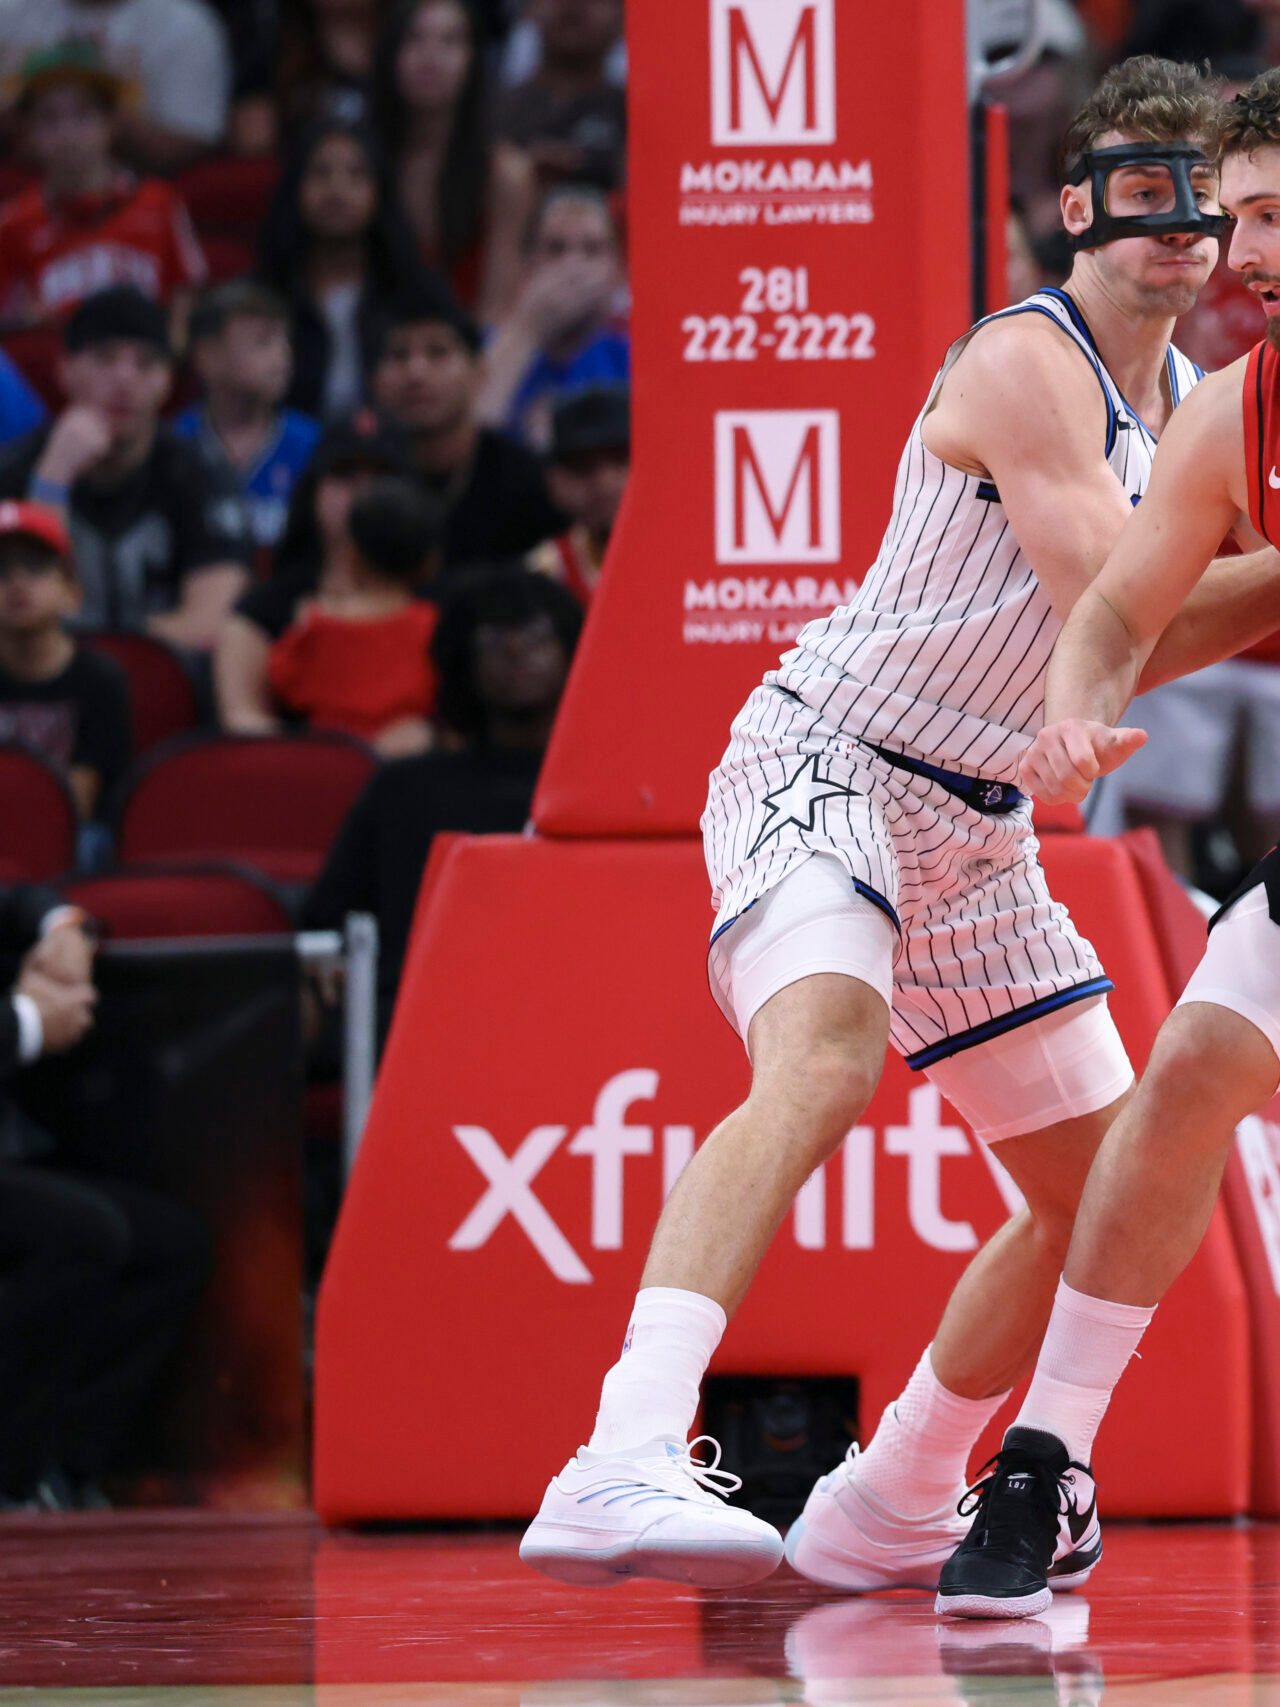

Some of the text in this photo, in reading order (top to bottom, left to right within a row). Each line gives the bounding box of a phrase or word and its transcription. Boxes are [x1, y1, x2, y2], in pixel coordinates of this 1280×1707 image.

[728, 4, 817, 132] M
[679, 160, 873, 193] MOKARAM
[679, 202, 874, 226] INJURY LAWYERS
[739, 266, 809, 313] 281
[681, 314, 876, 362] 222-2222
[732, 424, 822, 550] M
[684, 621, 765, 645] INJURY
